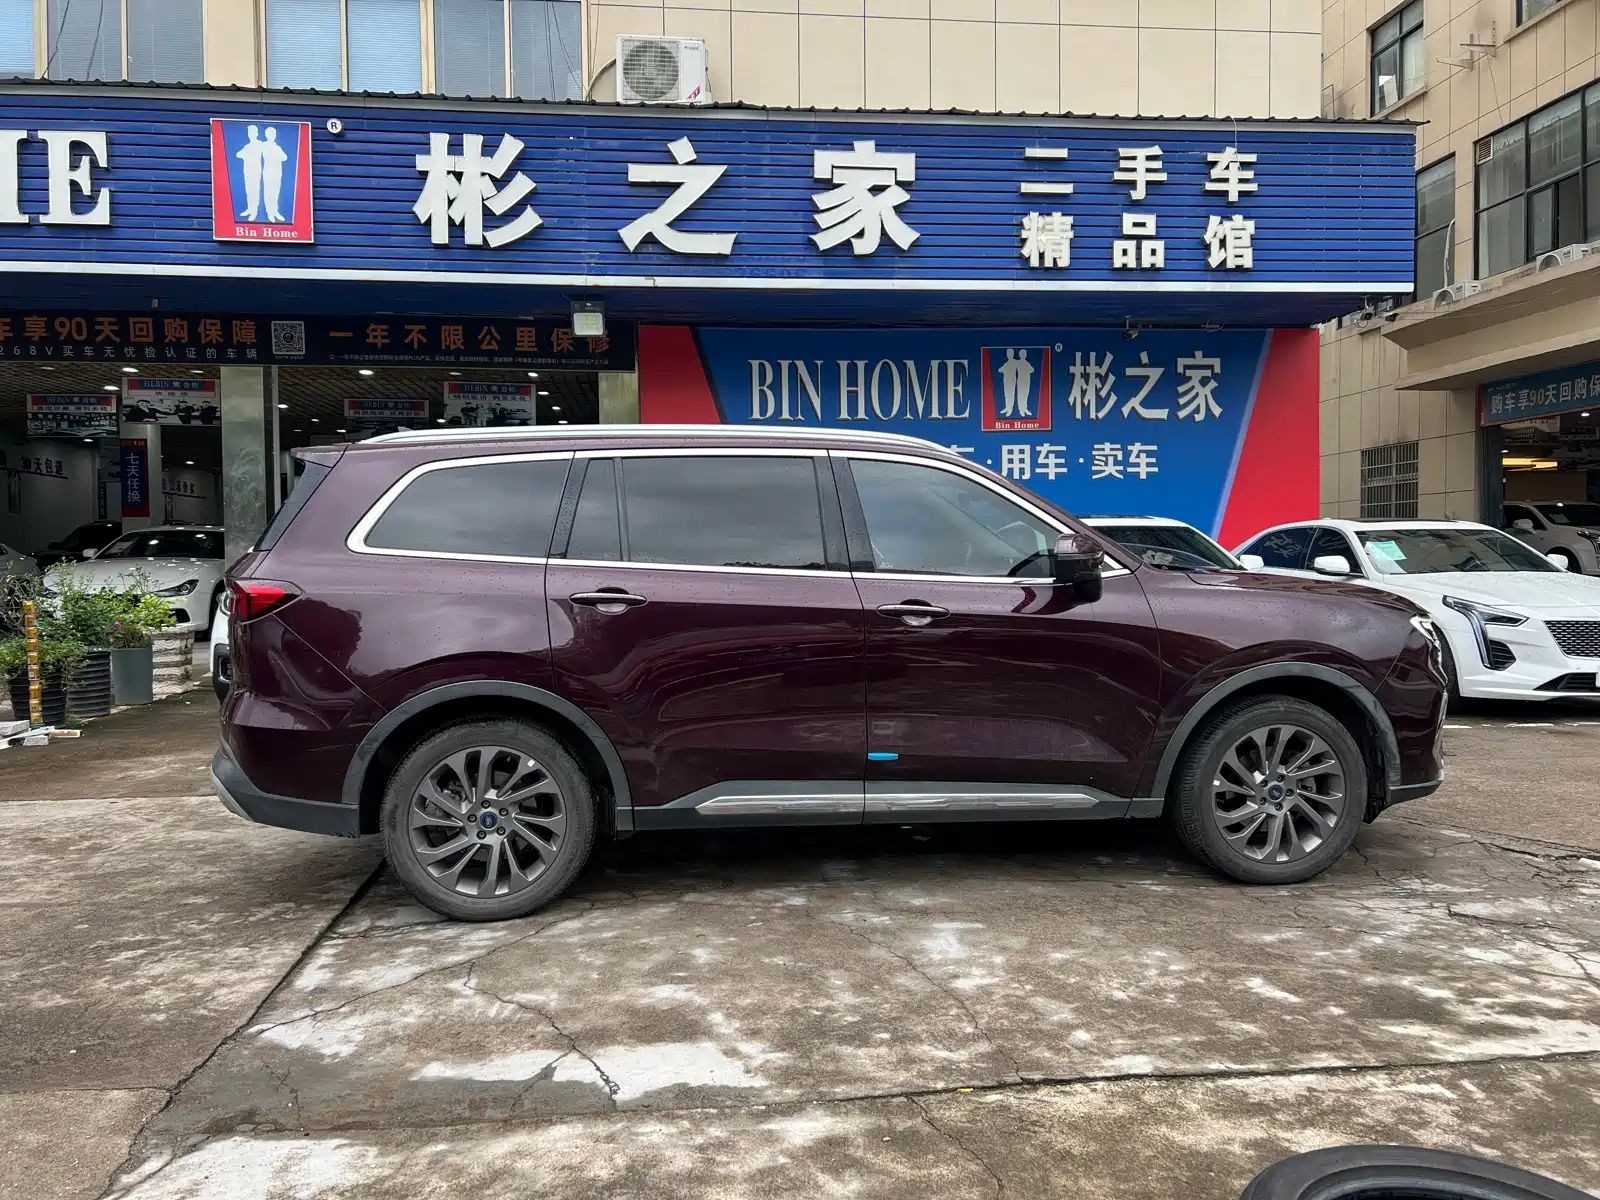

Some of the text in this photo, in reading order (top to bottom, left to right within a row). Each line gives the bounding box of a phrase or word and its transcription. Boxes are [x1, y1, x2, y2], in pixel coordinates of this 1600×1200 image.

[412, 132, 921, 256] 彬之家
[1019, 145, 1259, 203] 二手车
[235, 226, 298, 239] Bin Home
[1020, 211, 1256, 269] 精品馆
[143, 380, 169, 389] HEBIN
[748, 359, 970, 422] BIN HOME
[1067, 350, 1223, 422] 彬之家
[994, 420, 1040, 430] Bin Home
[125, 452, 141, 504] 七天任换
